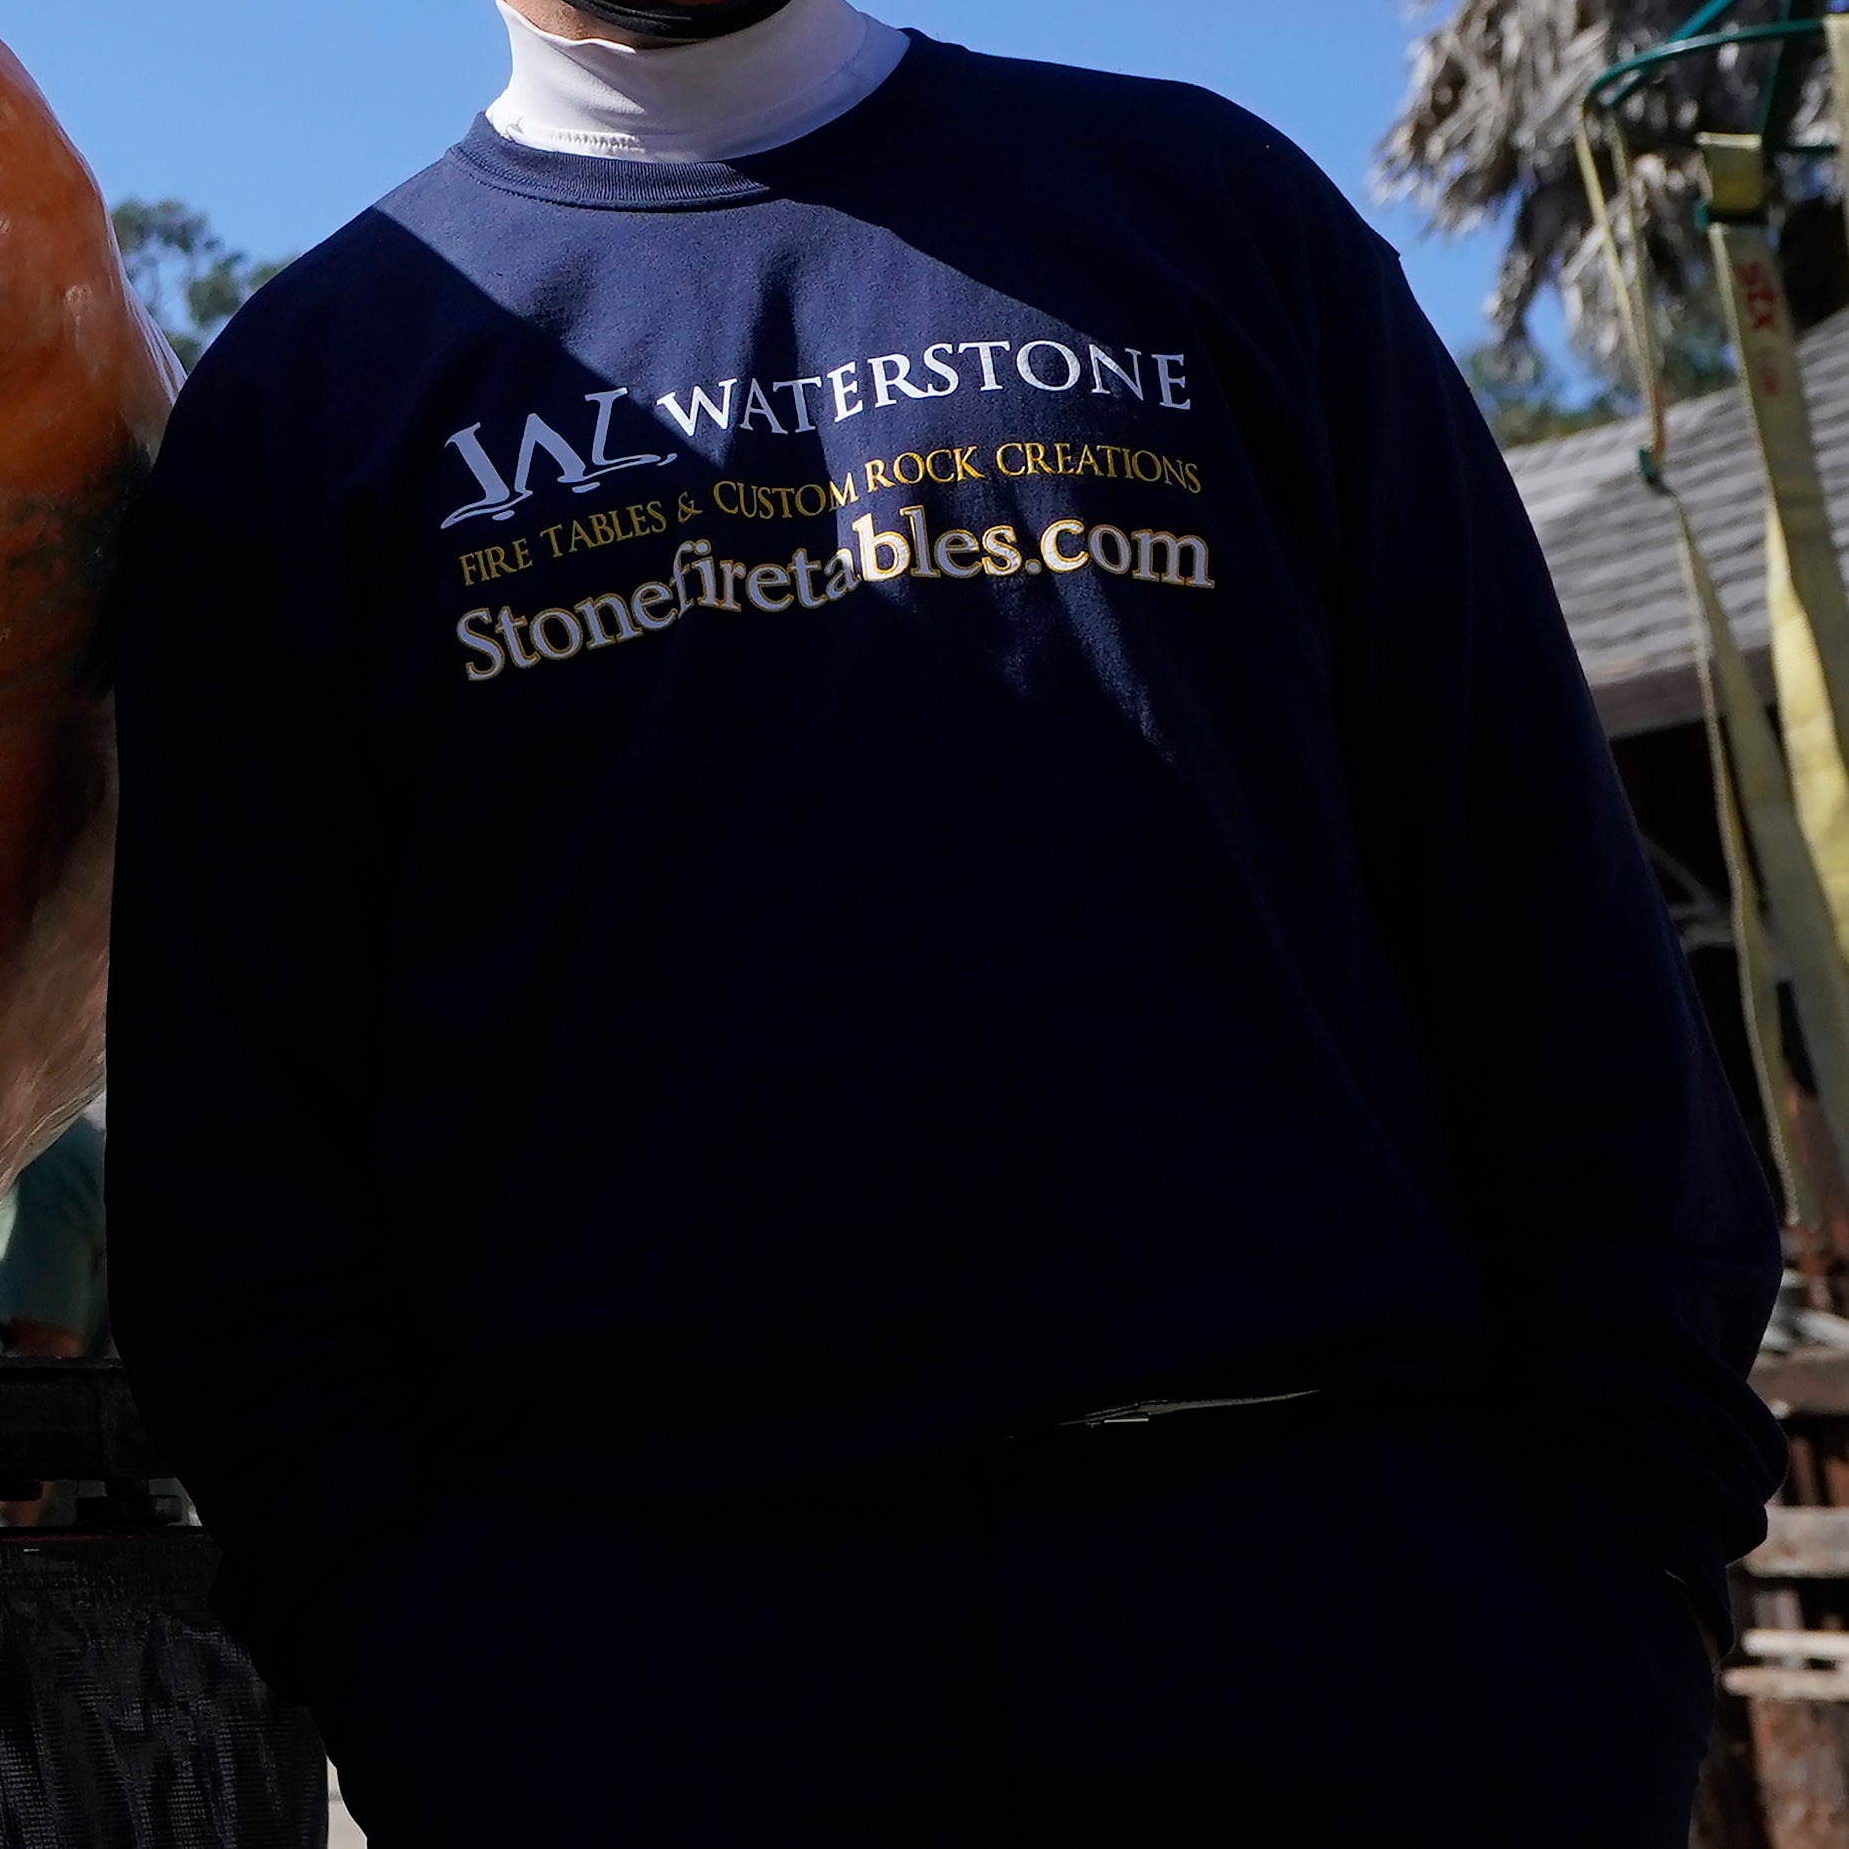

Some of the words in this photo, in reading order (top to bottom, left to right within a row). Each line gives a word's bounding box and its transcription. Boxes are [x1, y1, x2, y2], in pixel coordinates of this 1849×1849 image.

[656, 338, 1192, 439] WATERSTONE
[458, 538, 534, 587] FIRE
[539, 500, 668, 559] TABLES
[676, 491, 703, 524] &
[711, 471, 860, 520] CUSTOM
[864, 445, 985, 494] ROCK
[995, 441, 1203, 495] CREATIONS
[455, 504, 1216, 683] Stonefiretables.com
